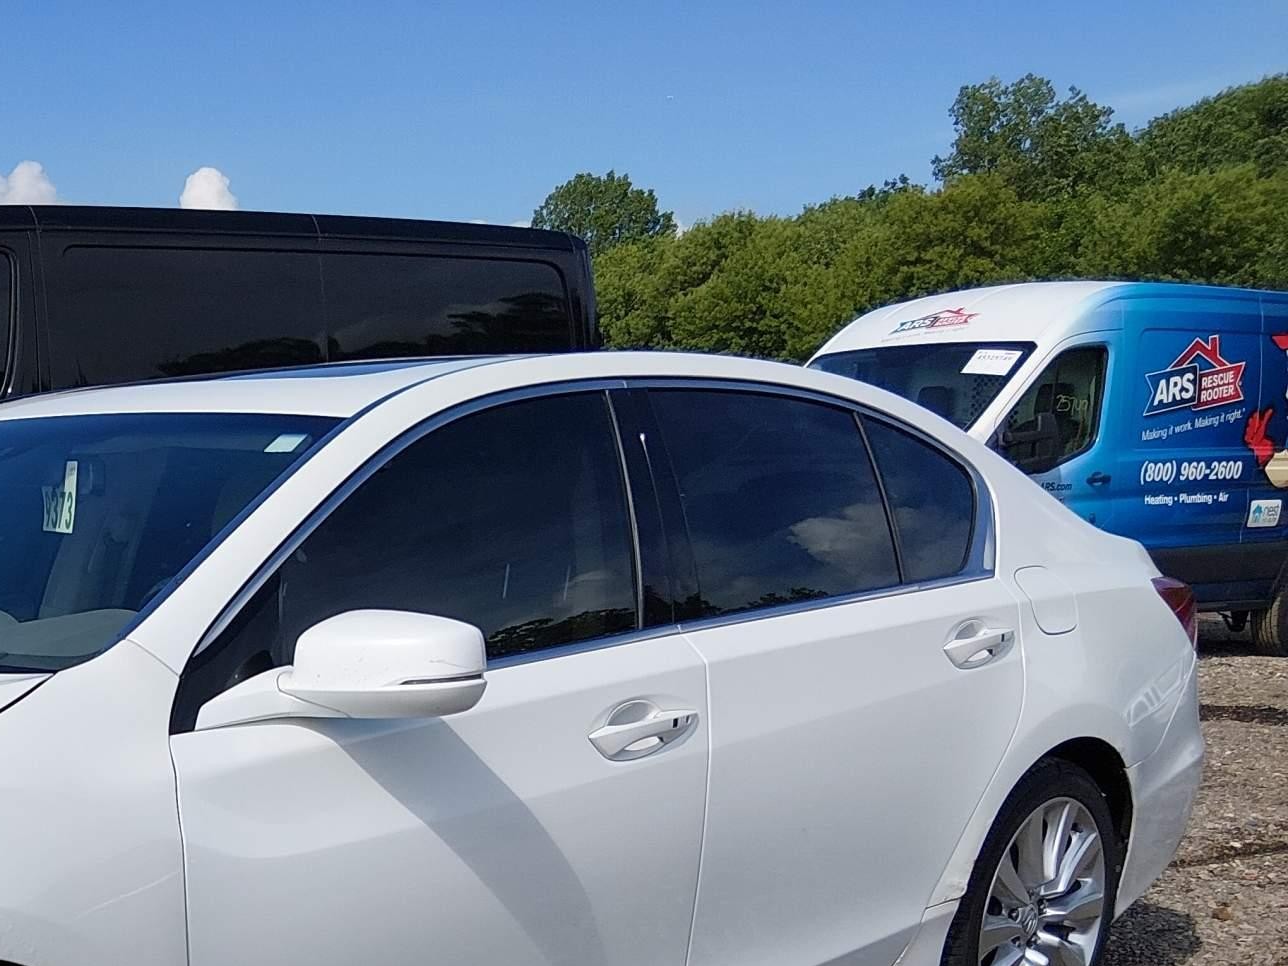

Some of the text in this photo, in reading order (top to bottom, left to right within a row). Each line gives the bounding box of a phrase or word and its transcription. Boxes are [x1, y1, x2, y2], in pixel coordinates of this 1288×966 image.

[898, 318, 934, 332] ARS
[1201, 371, 1235, 389] RESCUE
[1152, 373, 1195, 406] ARS
[1200, 384, 1235, 402] ROOTER
[1141, 428, 1168, 441] Making
[1175, 421, 1193, 433] work.
[1195, 415, 1219, 429] Making
[1140, 460, 1243, 485] (800) 960-2600
[1144, 491, 1229, 506] Heating Plumbing Air
